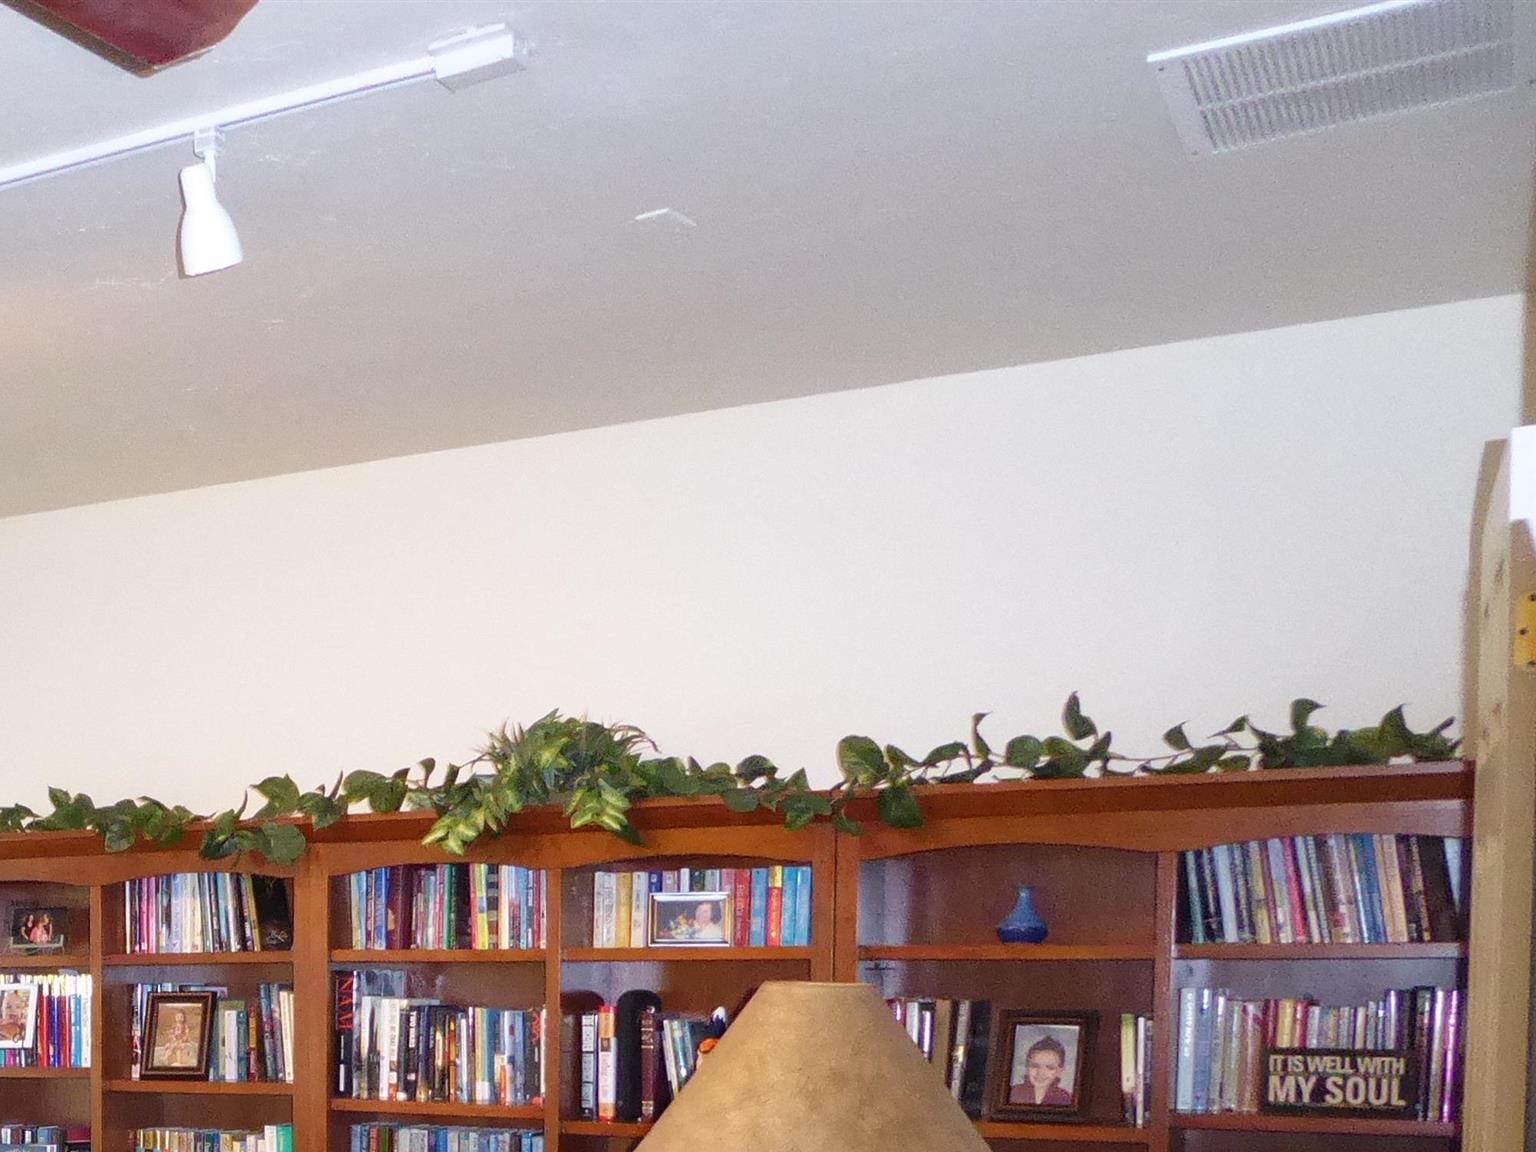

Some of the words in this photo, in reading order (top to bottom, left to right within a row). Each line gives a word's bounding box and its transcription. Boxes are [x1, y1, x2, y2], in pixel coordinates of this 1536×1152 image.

[1268, 1054, 1284, 1073] IT
[1287, 1055, 1305, 1073] IS
[1307, 1055, 1353, 1074] WELL
[1357, 1056, 1406, 1075] WITH
[1268, 1075, 1317, 1103] MY
[1324, 1076, 1407, 1106] SOUL
